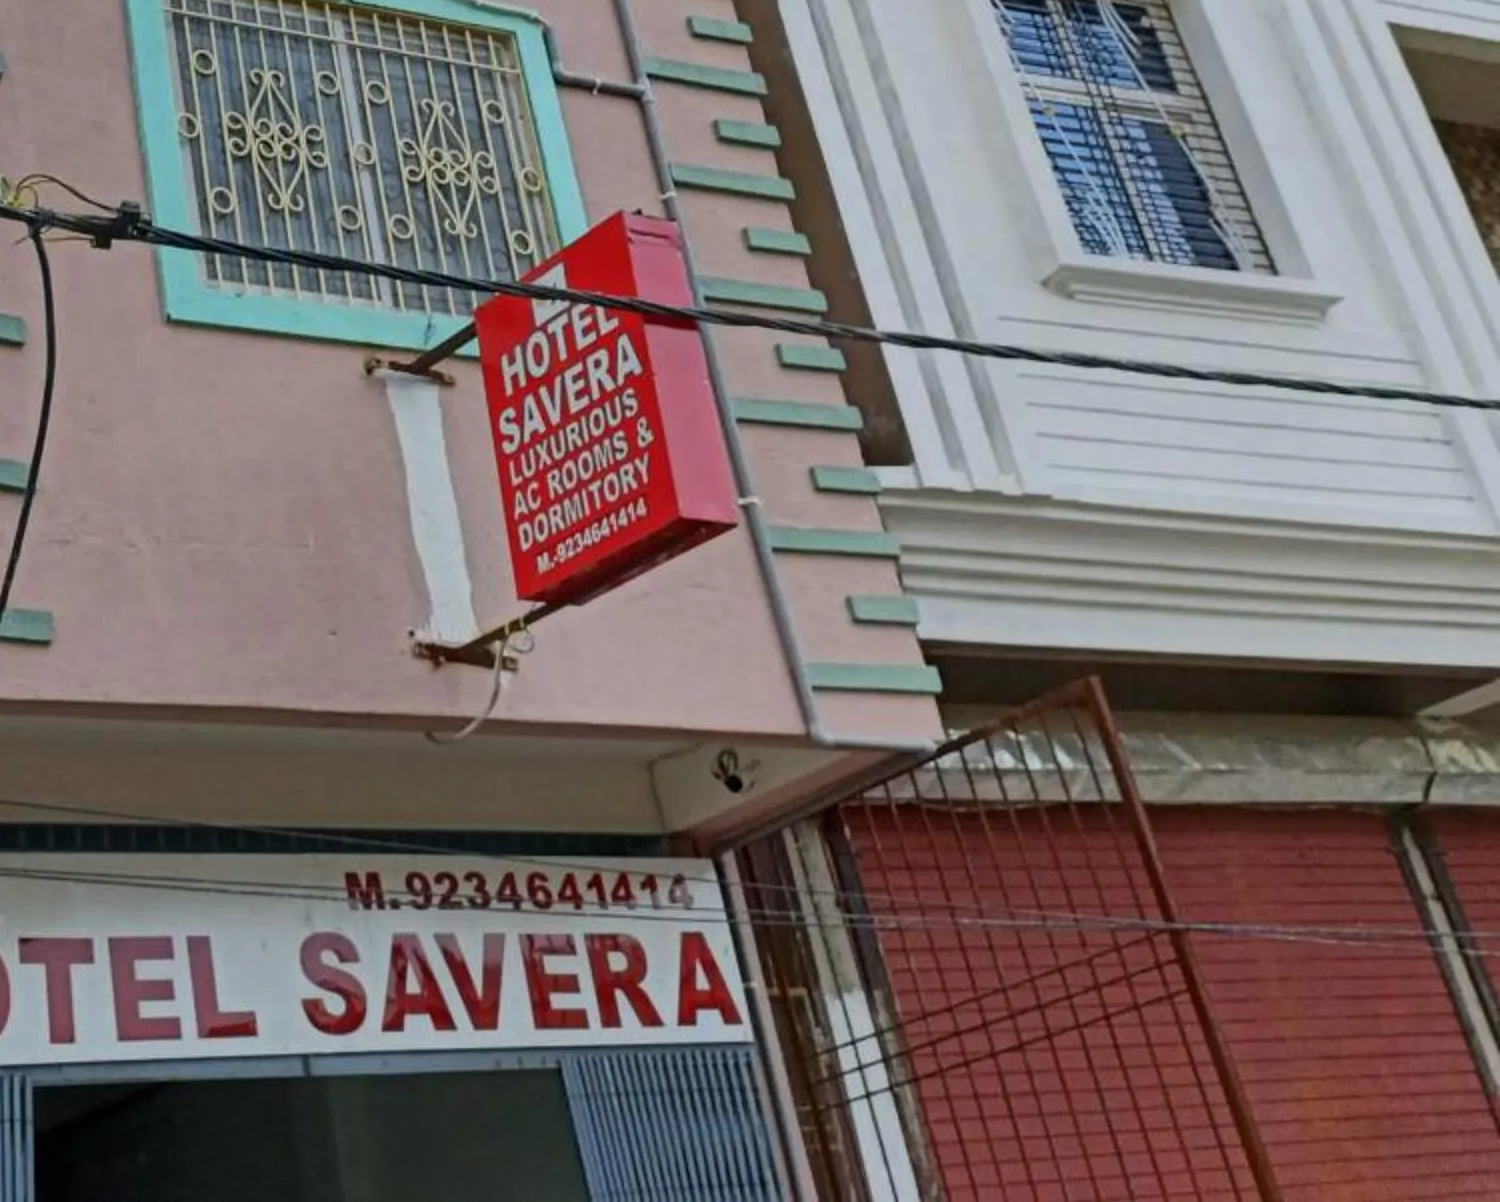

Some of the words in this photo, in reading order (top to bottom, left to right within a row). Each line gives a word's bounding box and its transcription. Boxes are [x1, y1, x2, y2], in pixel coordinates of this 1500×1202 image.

[499, 333, 643, 454] SAVERA
[501, 302, 619, 397] HOTEL
[509, 389, 638, 486] LUXURIOUS
[514, 482, 541, 520] AC
[547, 430, 629, 500] ROOMS
[637, 416, 654, 448] &
[518, 452, 649, 552] DORMITORY
[300, 931, 743, 1035] SAVERA
